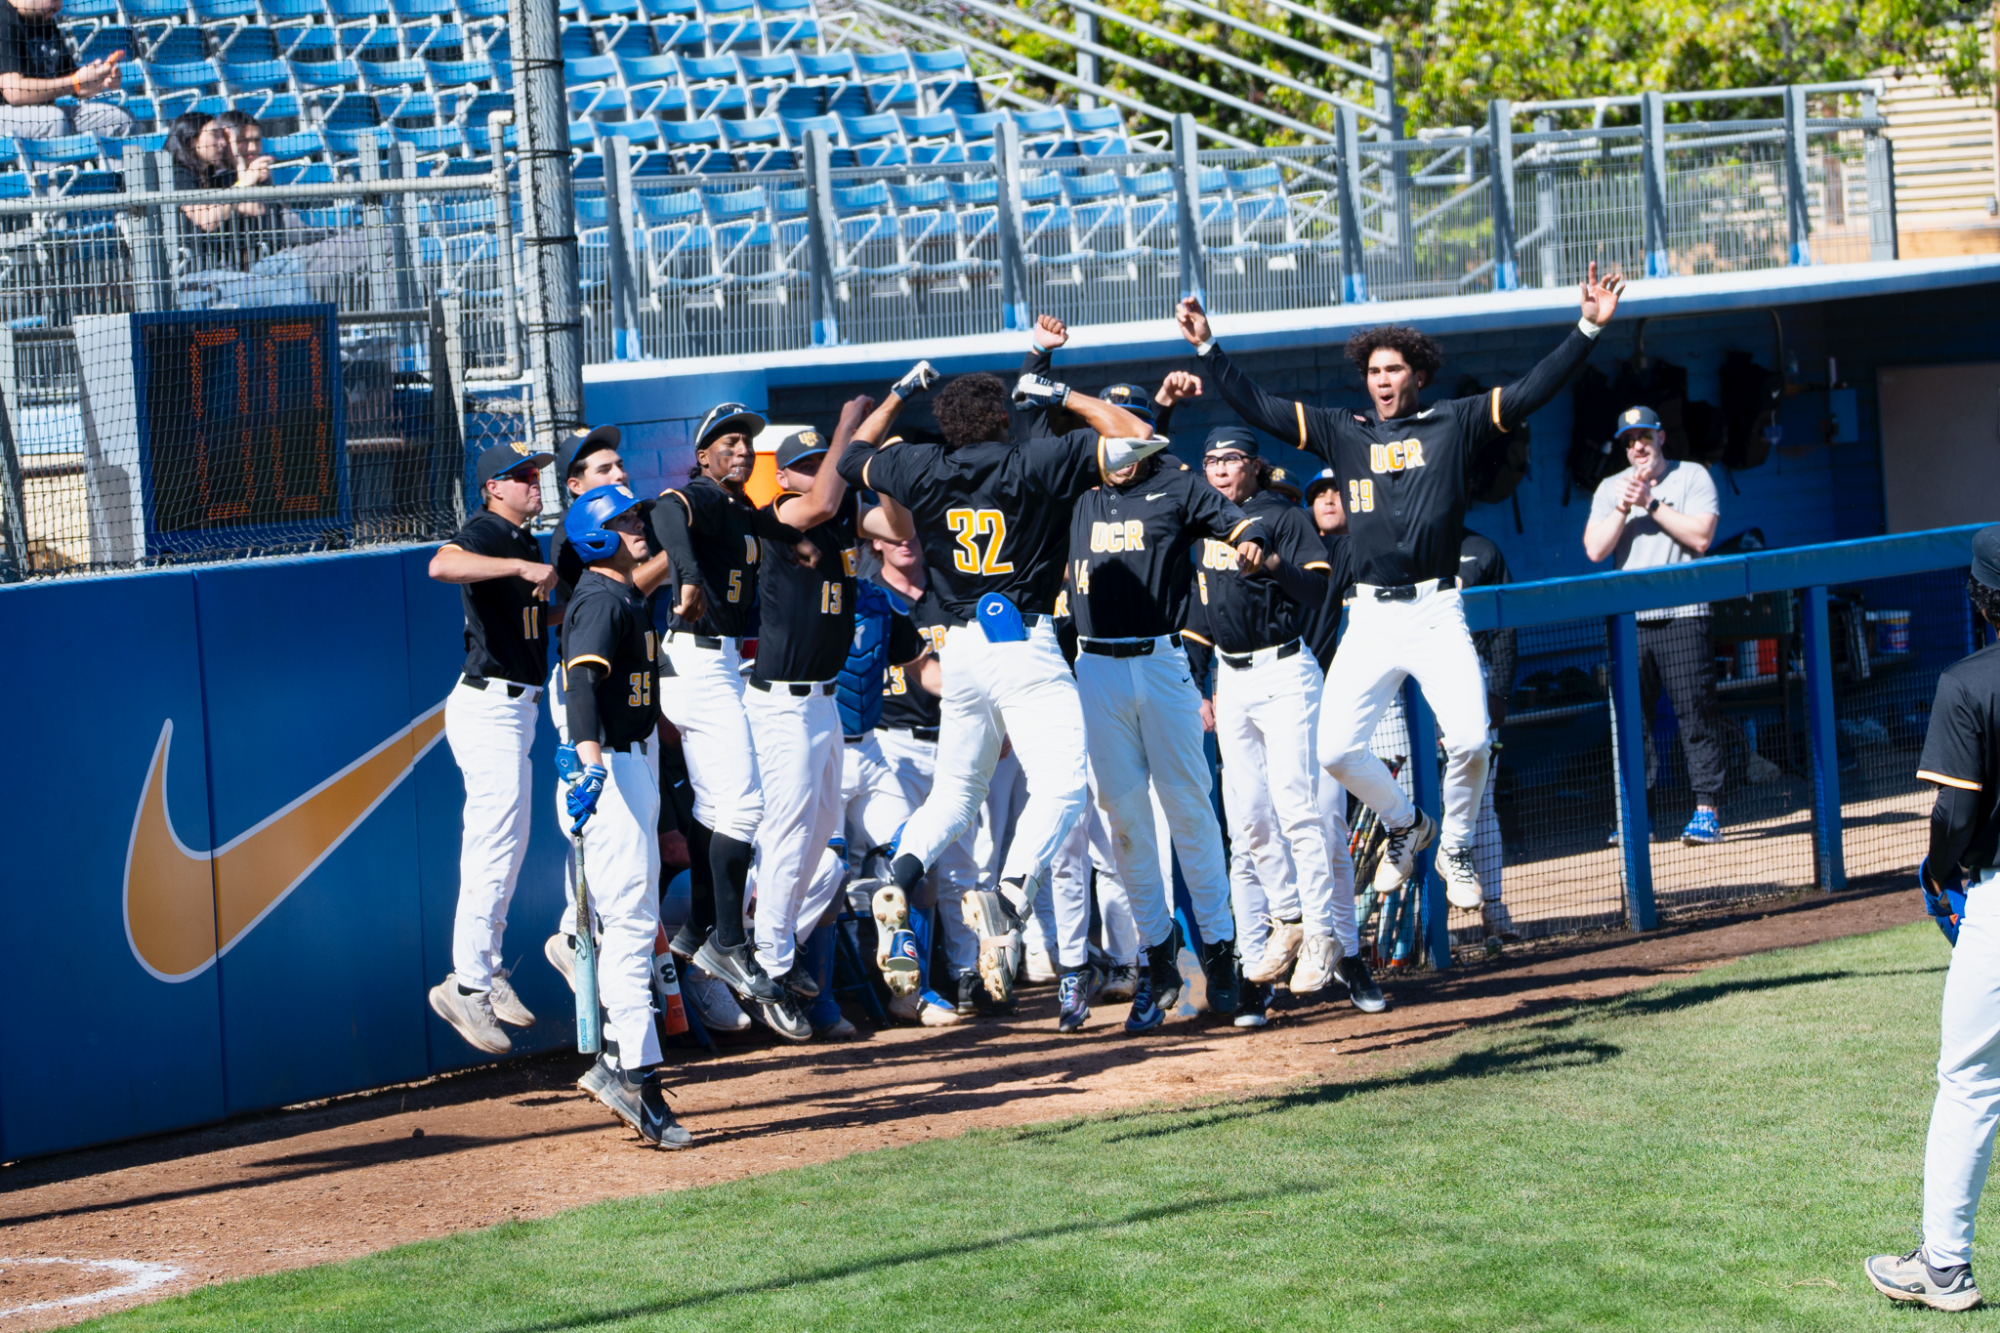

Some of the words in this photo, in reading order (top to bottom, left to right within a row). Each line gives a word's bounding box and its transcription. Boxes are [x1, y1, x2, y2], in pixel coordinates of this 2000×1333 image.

[189, 323, 329, 520] 00
[798, 431, 819, 447] UCR
[1370, 438, 1426, 474] UCR
[1349, 478, 1375, 513] 39
[946, 508, 1015, 577] 32
[1090, 520, 1146, 553] UCR
[727, 569, 742, 603] 5
[821, 580, 842, 615] 13
[523, 606, 539, 639] 11
[629, 671, 651, 707] 35
